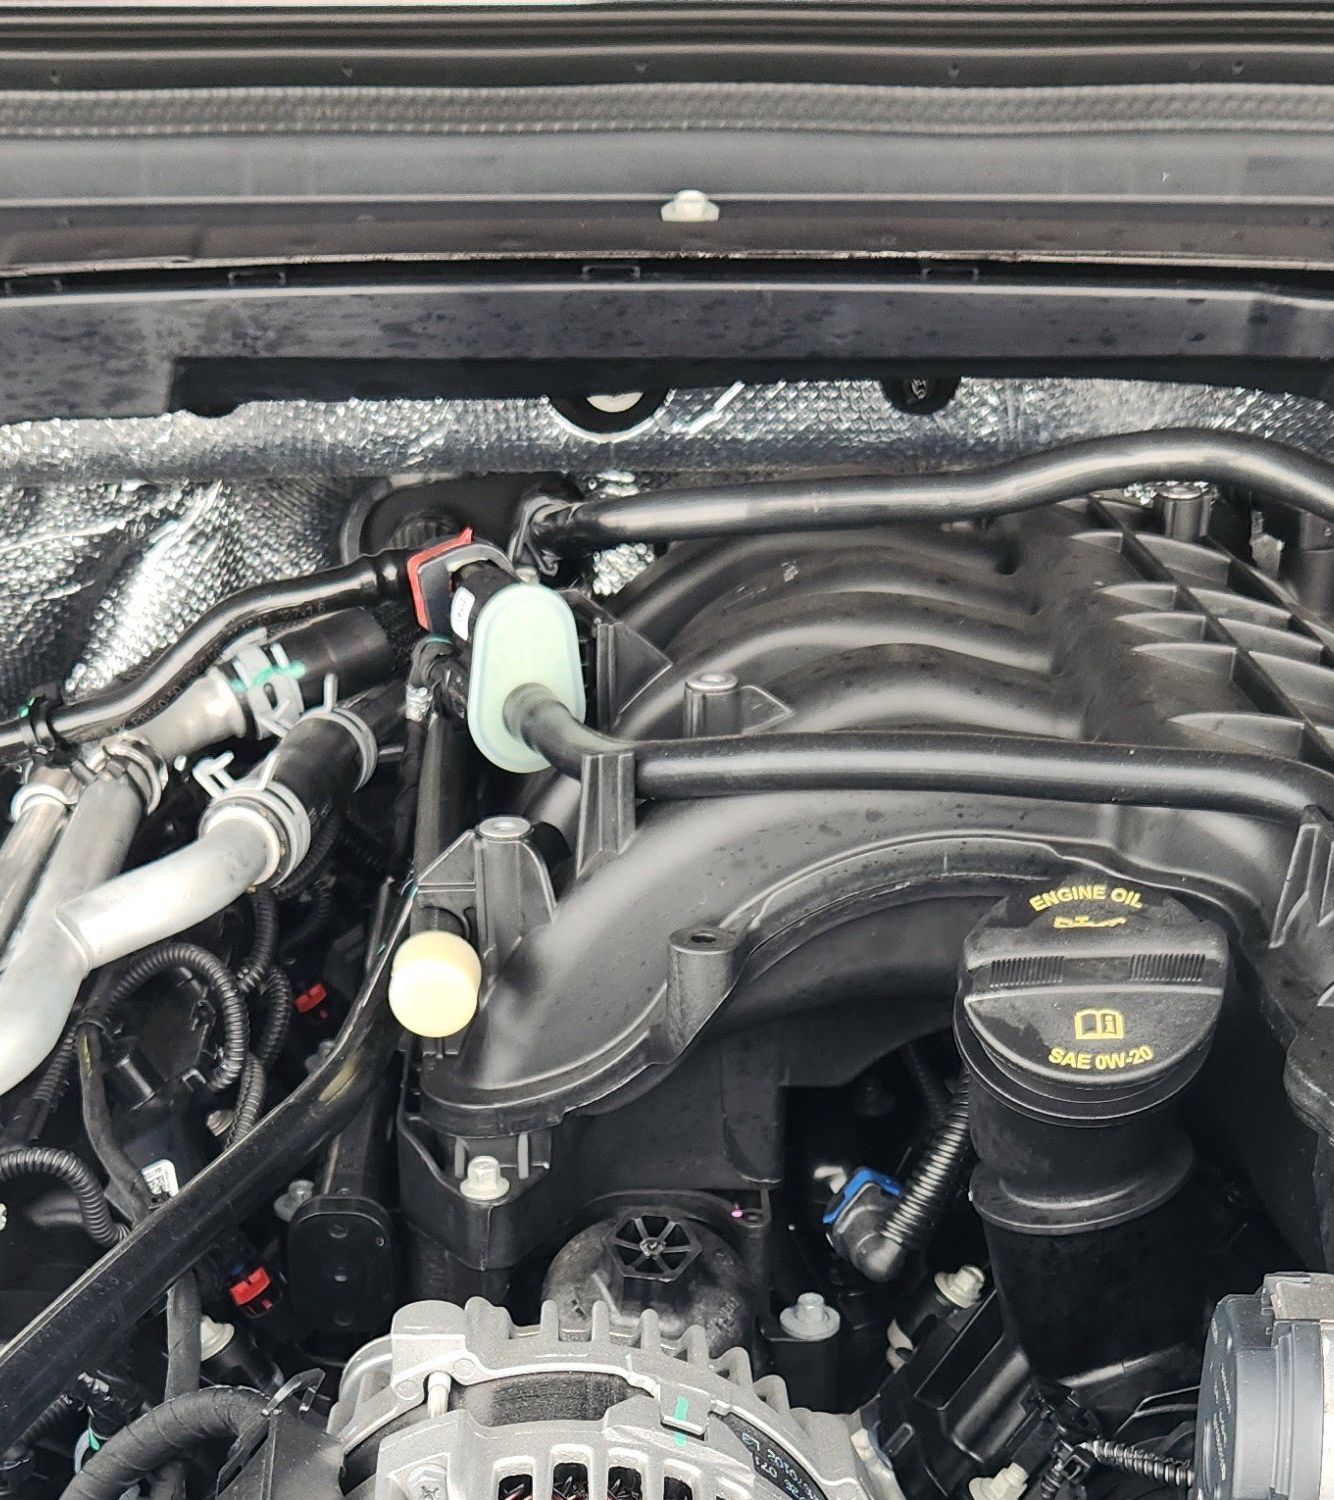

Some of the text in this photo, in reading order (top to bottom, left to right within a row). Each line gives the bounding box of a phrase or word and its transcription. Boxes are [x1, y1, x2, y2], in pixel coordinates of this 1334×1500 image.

[1029, 885, 1144, 912] ENGINE OIL
[1048, 1044, 1154, 1070] SAE 0W-20
